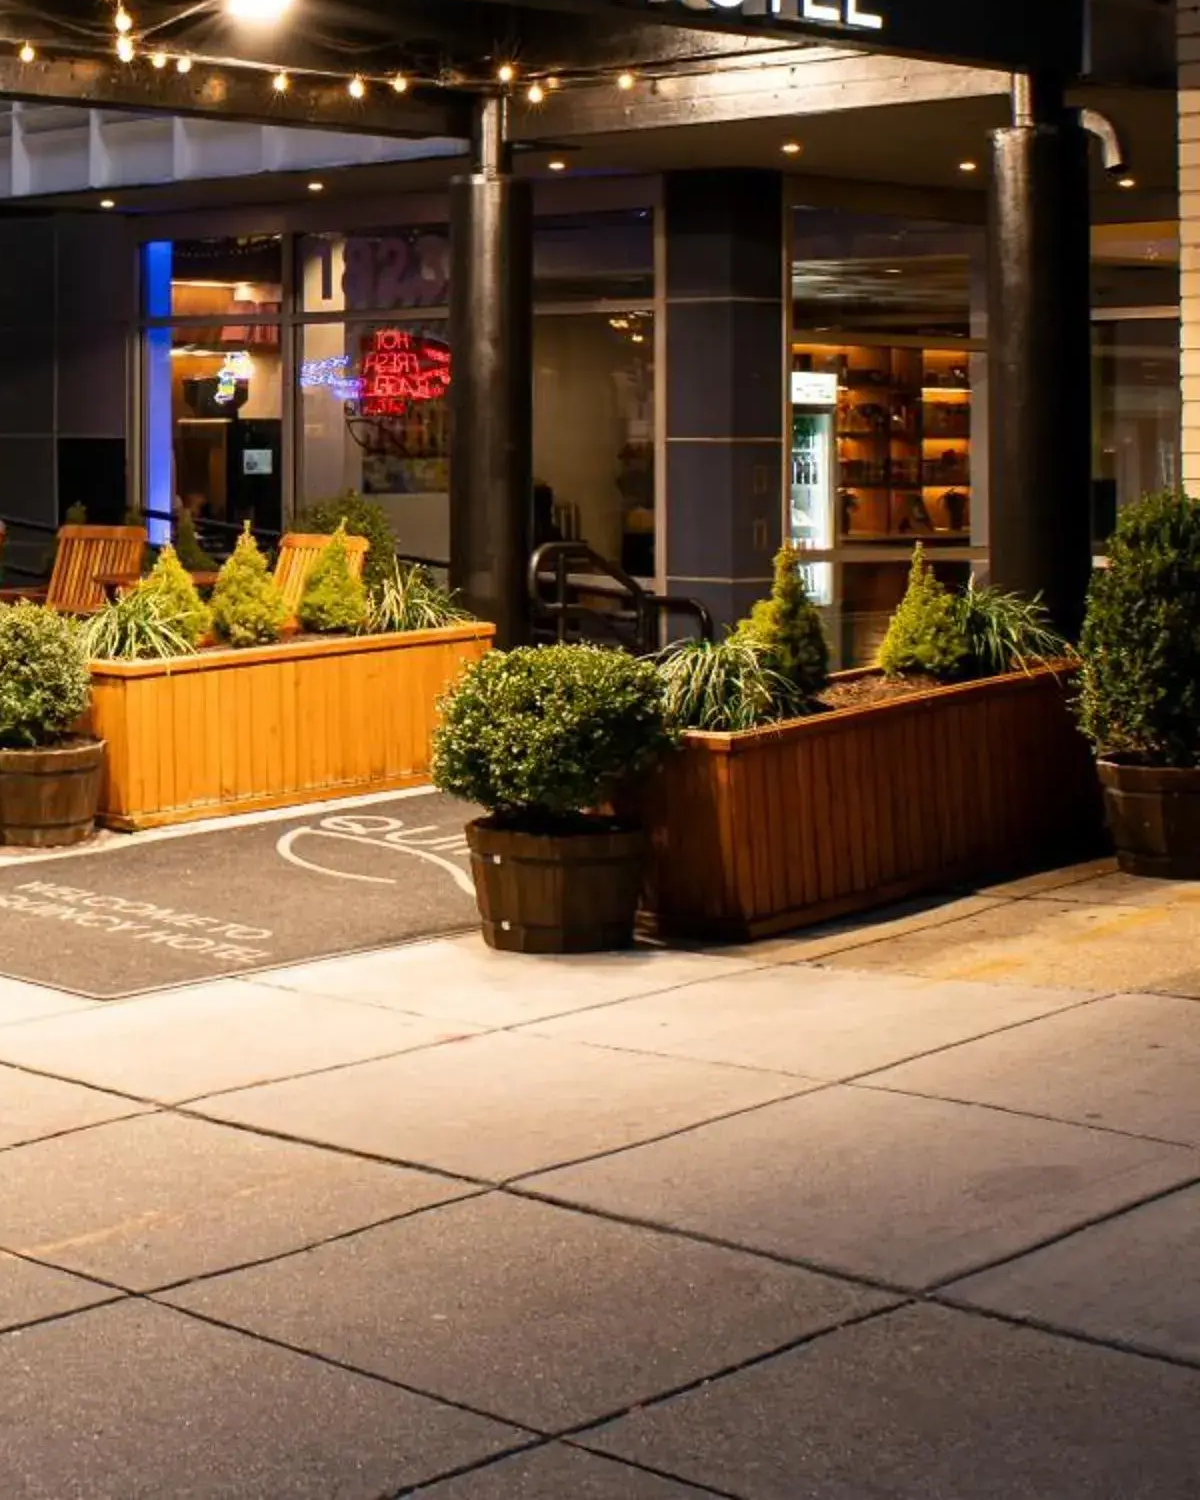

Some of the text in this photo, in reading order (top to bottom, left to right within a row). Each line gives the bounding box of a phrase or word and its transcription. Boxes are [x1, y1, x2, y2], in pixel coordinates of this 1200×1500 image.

[16, 881, 273, 940] WELCOME TO
[131, 930, 272, 965] HOTEL
